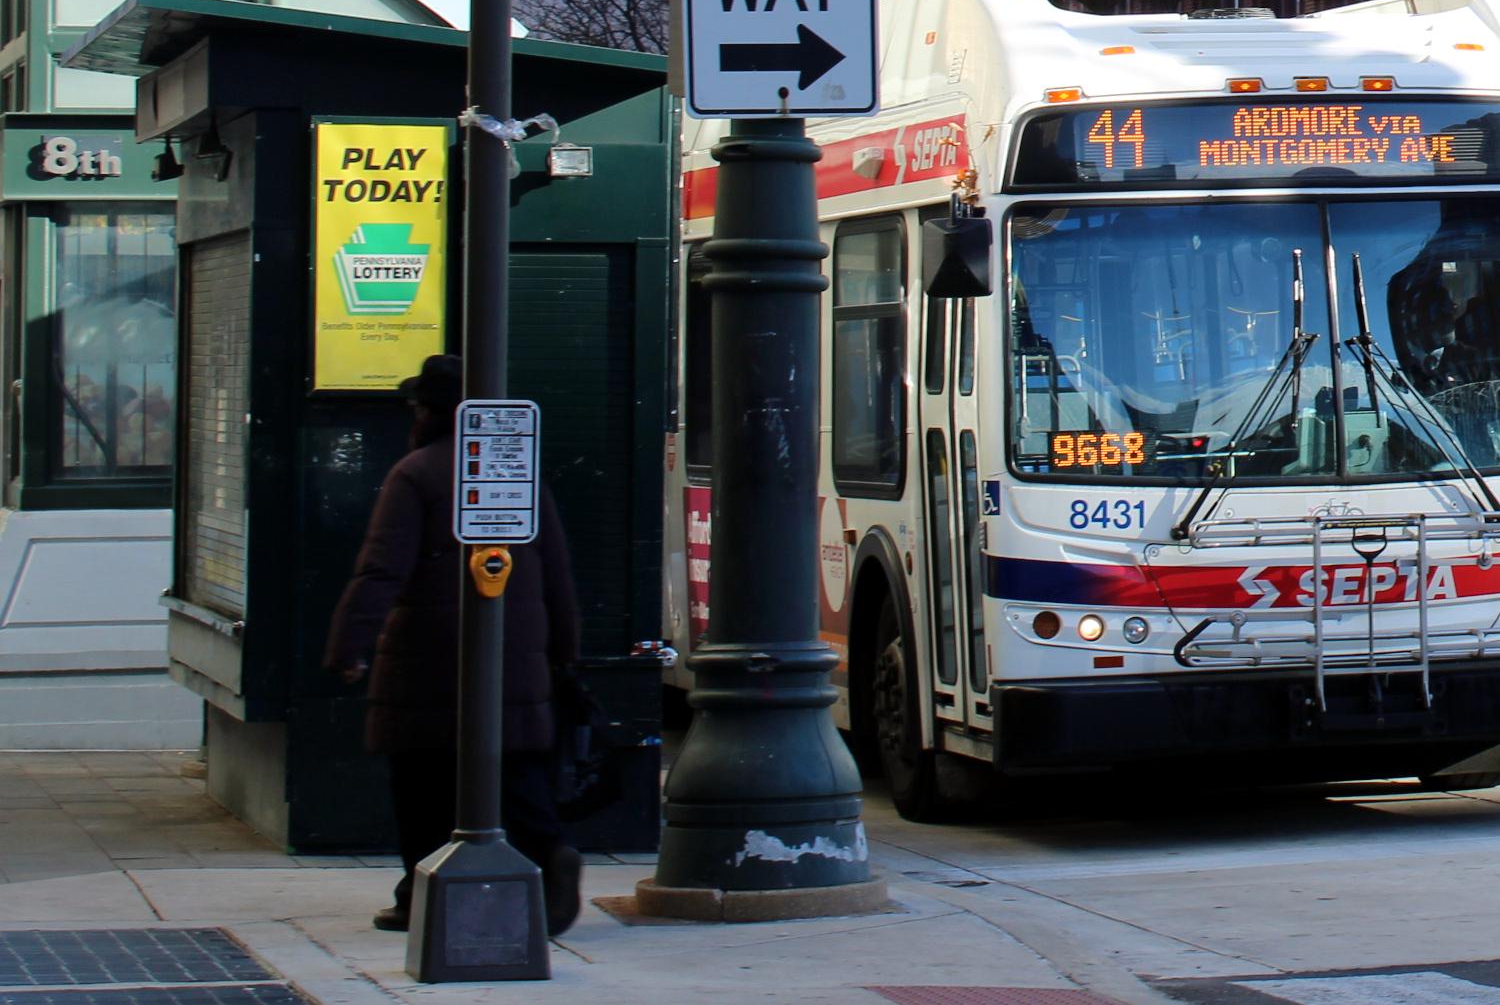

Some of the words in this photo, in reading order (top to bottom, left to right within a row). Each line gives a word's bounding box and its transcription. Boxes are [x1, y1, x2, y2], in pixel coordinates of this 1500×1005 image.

[1232, 105, 1364, 138] ARDMORE
[911, 123, 958, 174] SEPTA
[1087, 107, 1145, 169] 44
[1198, 137, 1390, 167] MONTGOMERY
[1399, 135, 1457, 164] AVE
[43, 135, 123, 178] 8th
[341, 147, 428, 171] PLAY
[323, 179, 445, 203] TODAY!
[353, 256, 423, 266] PENNSYLVANIA
[353, 266, 423, 279] LOTTERY
[1053, 432, 1145, 467] 9668
[1069, 498, 1146, 530] 8431
[1295, 564, 1458, 608] SEPTA
